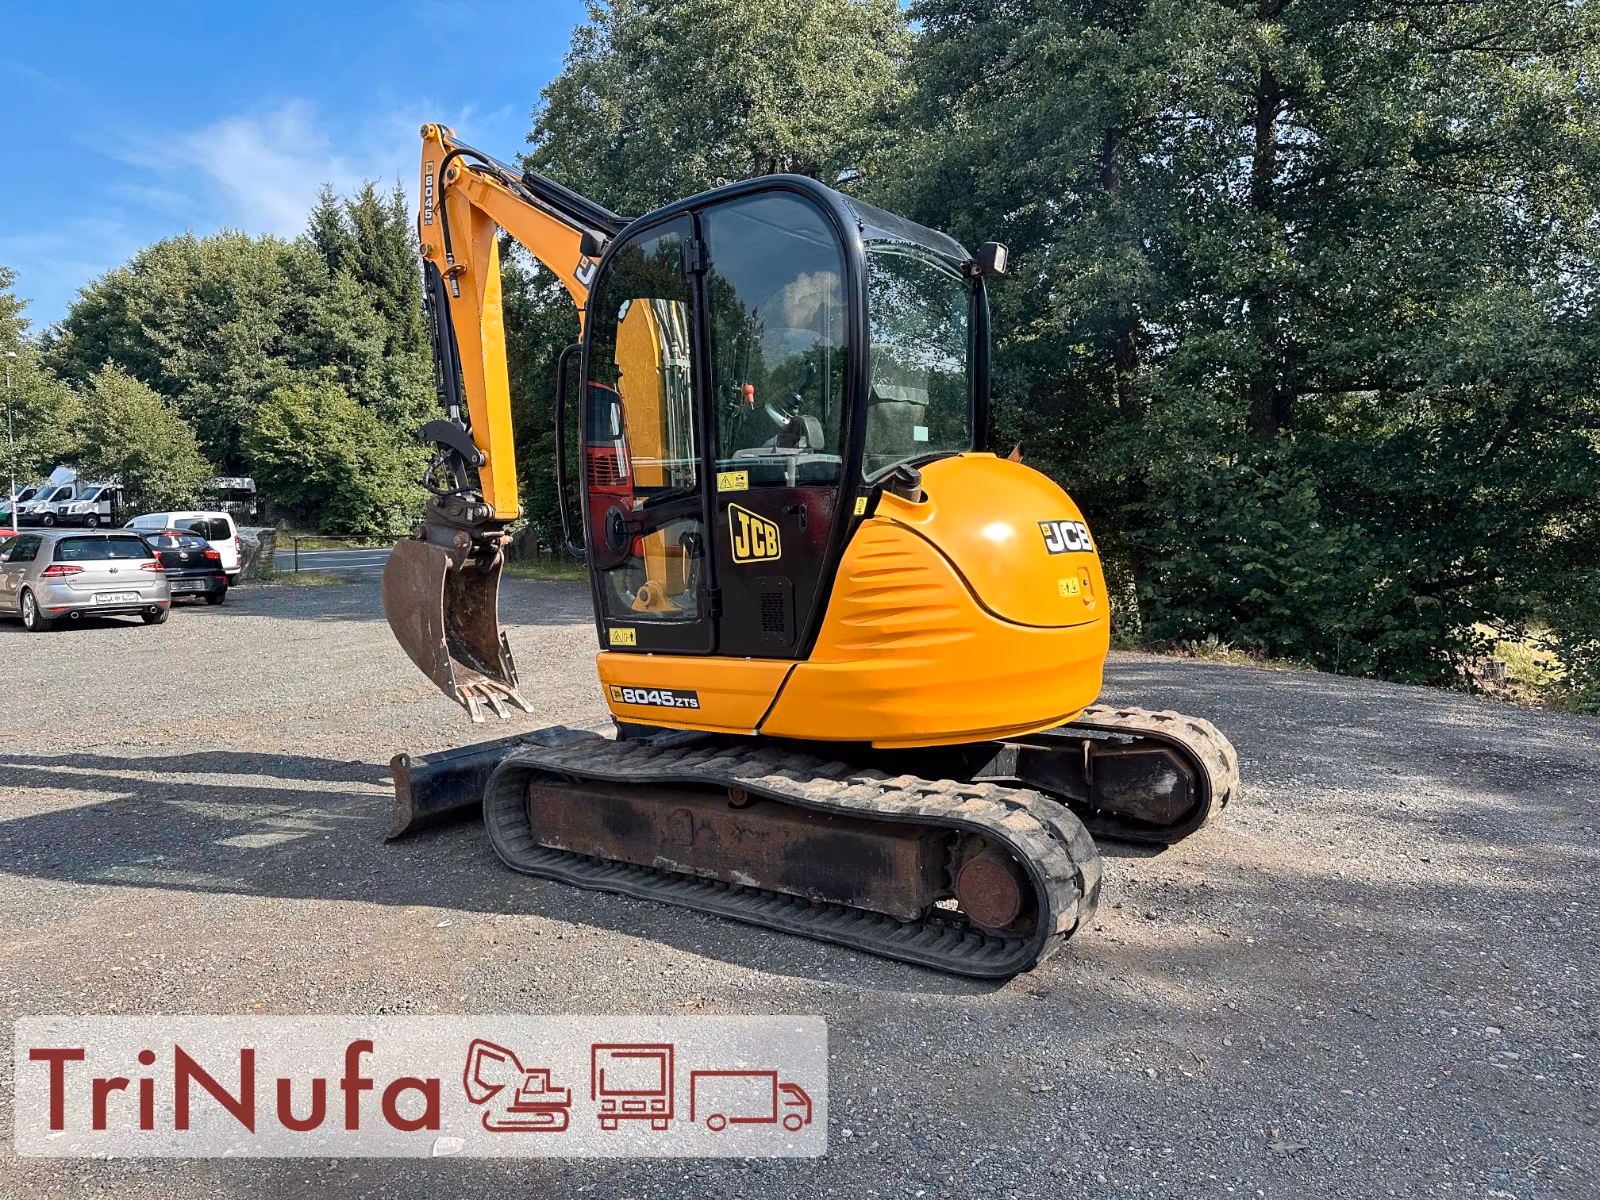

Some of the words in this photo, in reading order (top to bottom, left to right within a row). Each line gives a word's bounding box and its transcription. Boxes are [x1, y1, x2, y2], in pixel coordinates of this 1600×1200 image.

[425, 175, 433, 218] 8045
[735, 511, 777, 557] JCB
[1045, 522, 1093, 552] JCB
